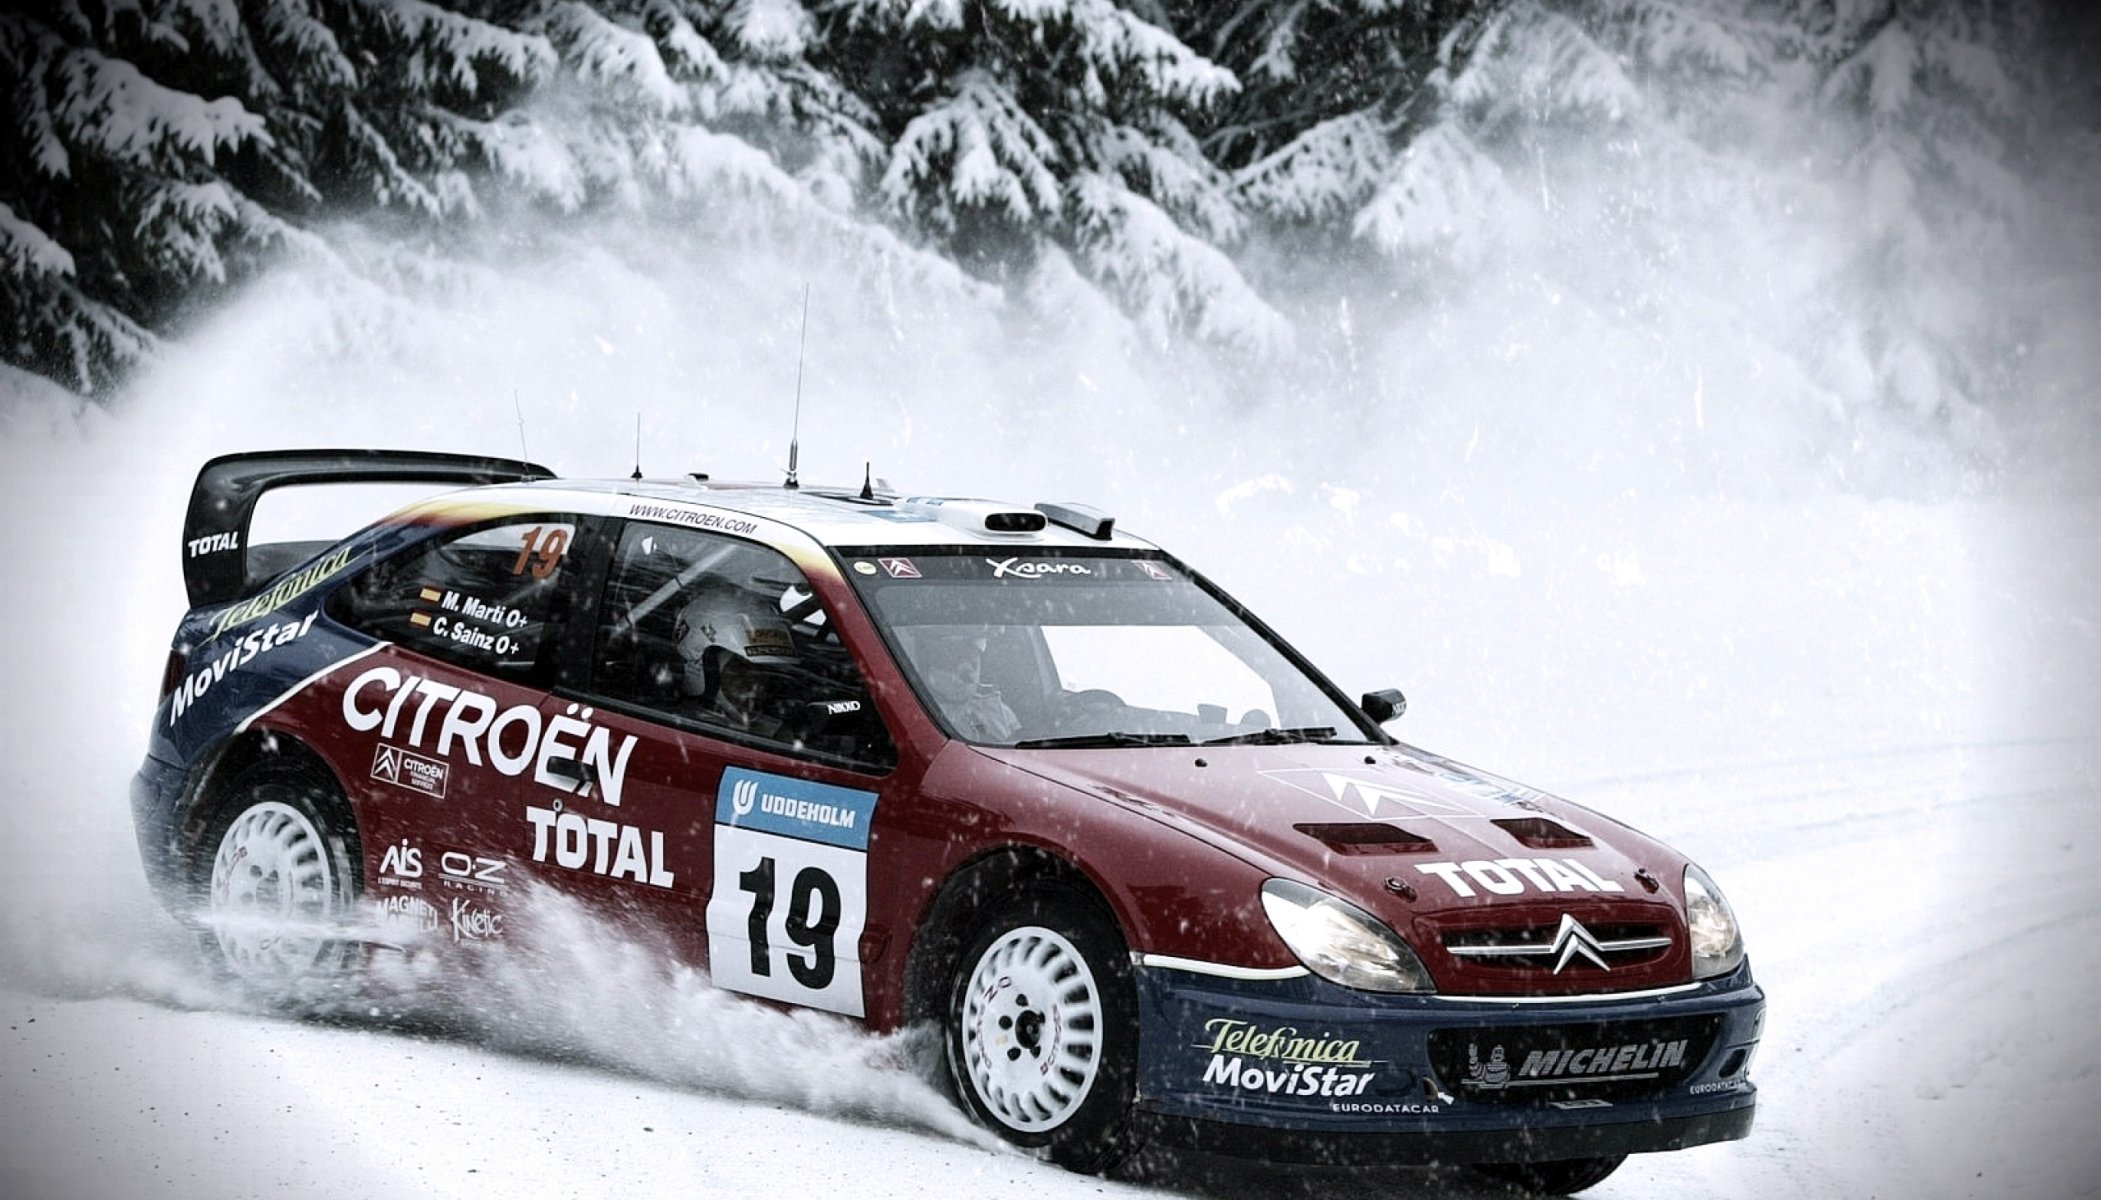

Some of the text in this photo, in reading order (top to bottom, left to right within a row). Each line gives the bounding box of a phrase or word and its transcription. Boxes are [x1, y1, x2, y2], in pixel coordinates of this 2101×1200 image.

[629, 503, 757, 534] WWW.CITROEN.COM
[188, 531, 238, 558] TOTAL
[512, 526, 568, 578] 19
[985, 557, 1092, 578] Xsara
[441, 591, 459, 612] M.
[462, 596, 506, 624] Marti
[433, 617, 448, 636] C.
[451, 622, 495, 650] Sainz
[170, 610, 319, 727] MoviStar
[342, 666, 638, 807] CITROËN
[761, 793, 856, 829] UDDEHOLM
[526, 806, 674, 889] TOTAL
[1414, 857, 1626, 899] TOTAL
[739, 856, 841, 990] 19
[1202, 1054, 1376, 1096] MoviStar
[1518, 1039, 1688, 1077] MICHELIN
[1332, 1102, 1440, 1114] EURODATACAR
